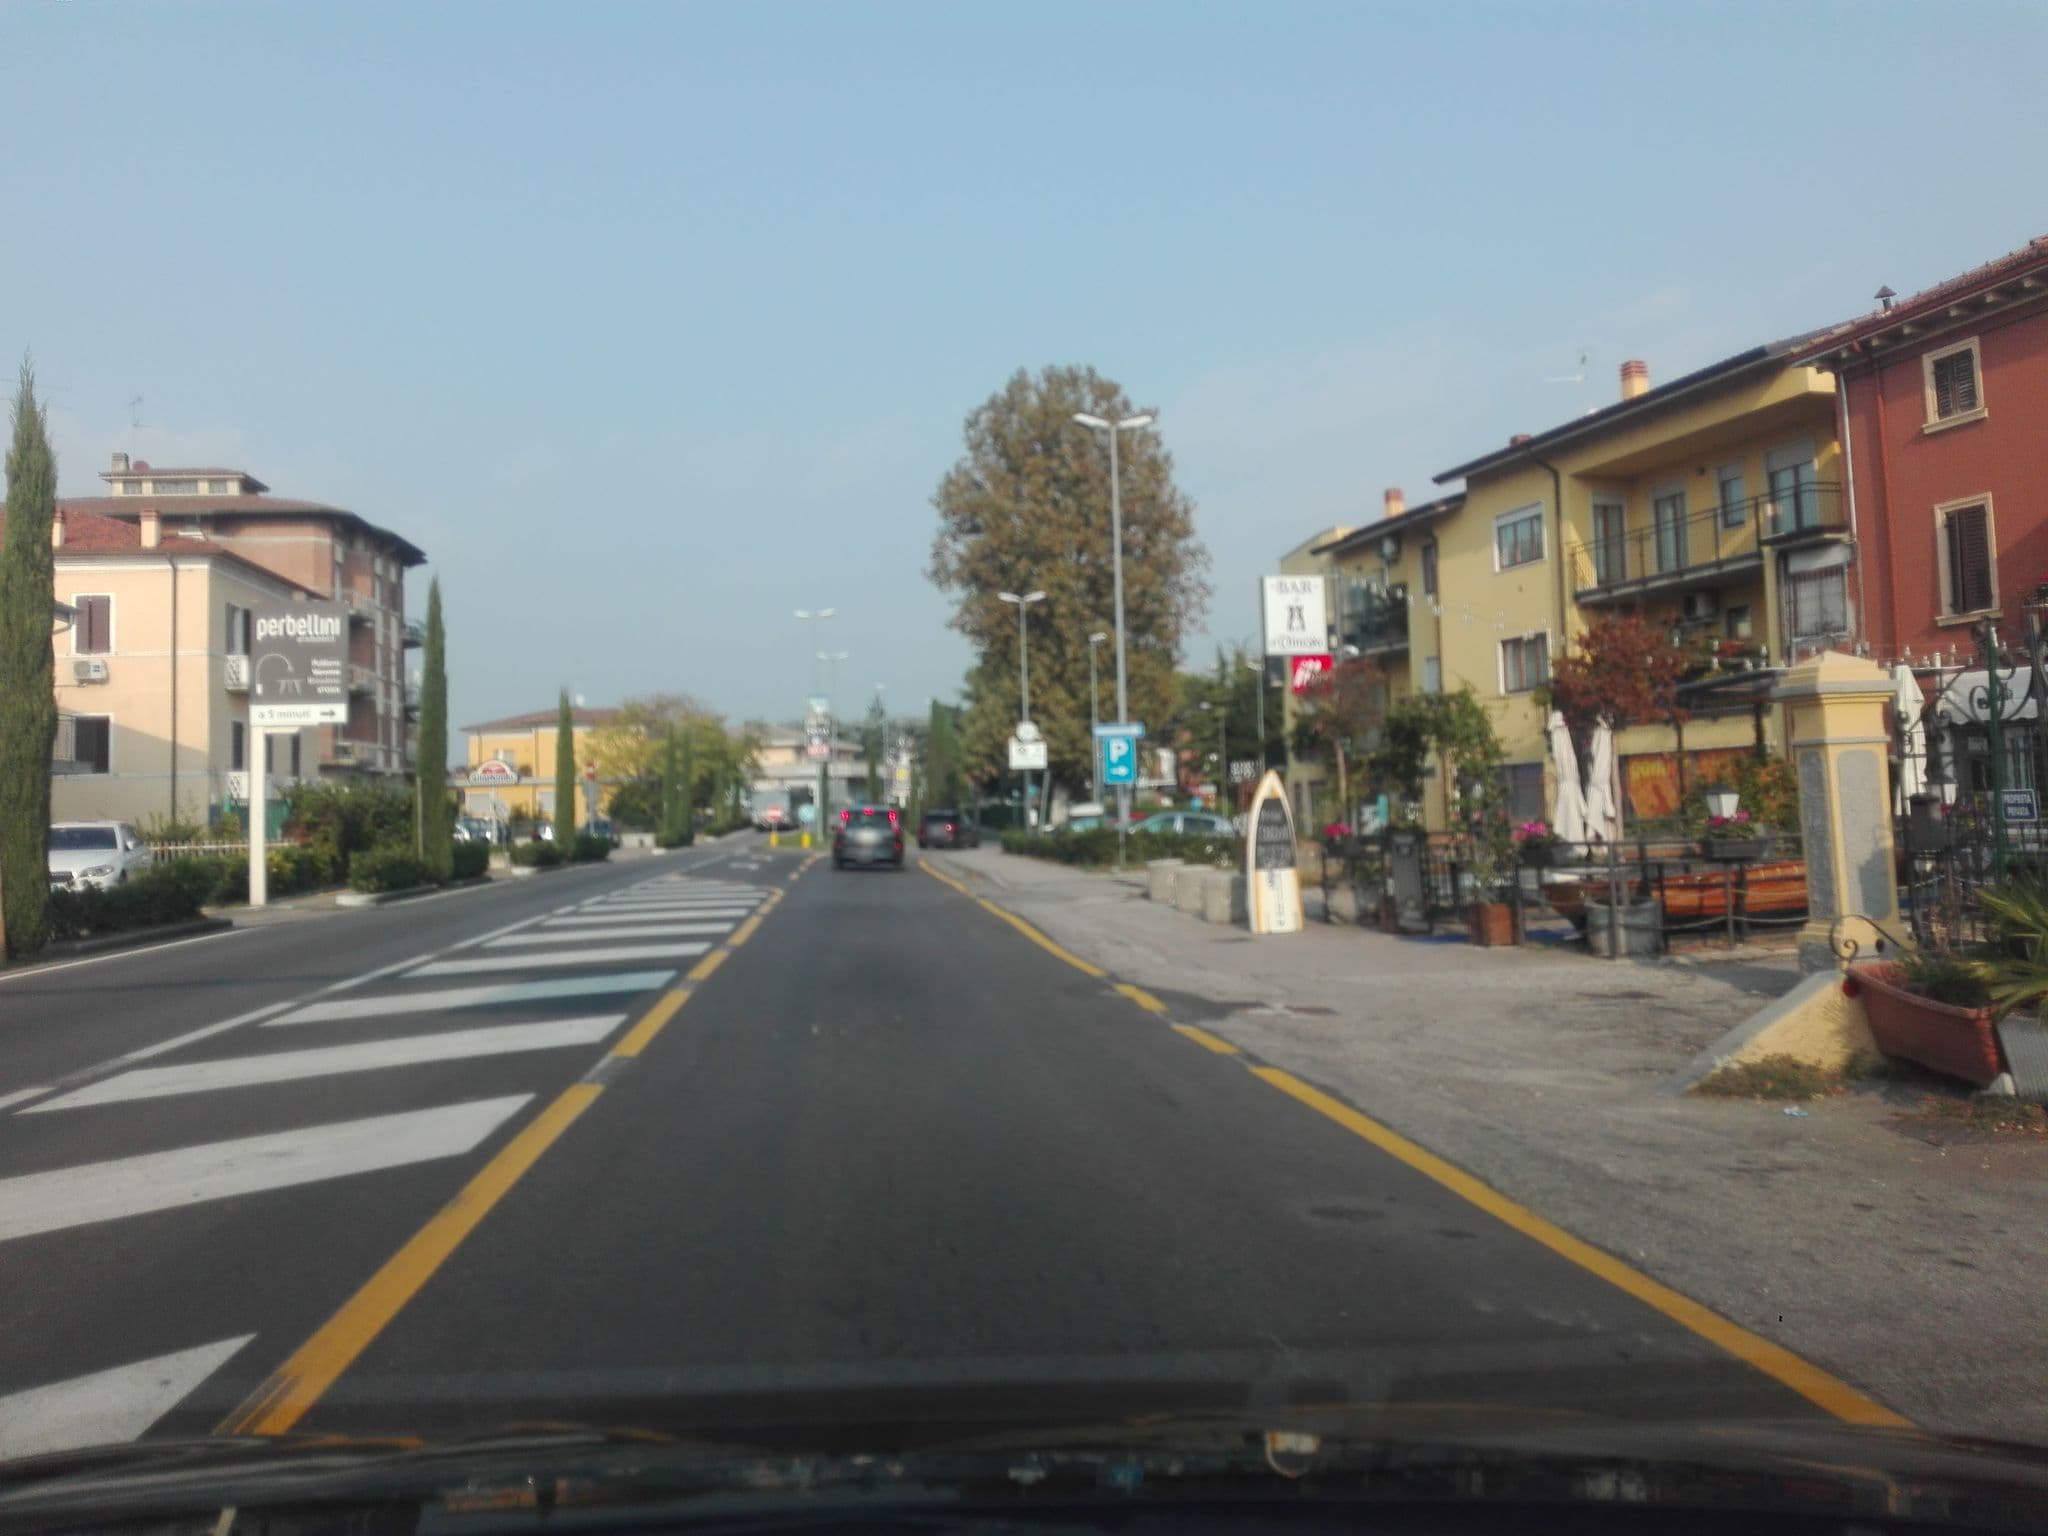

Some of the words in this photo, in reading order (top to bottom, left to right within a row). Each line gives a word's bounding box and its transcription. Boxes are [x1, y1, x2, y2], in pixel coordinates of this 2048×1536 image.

[1279, 582, 1312, 593] BAR
[256, 614, 340, 641] perbellini
[1109, 739, 1129, 763] P
